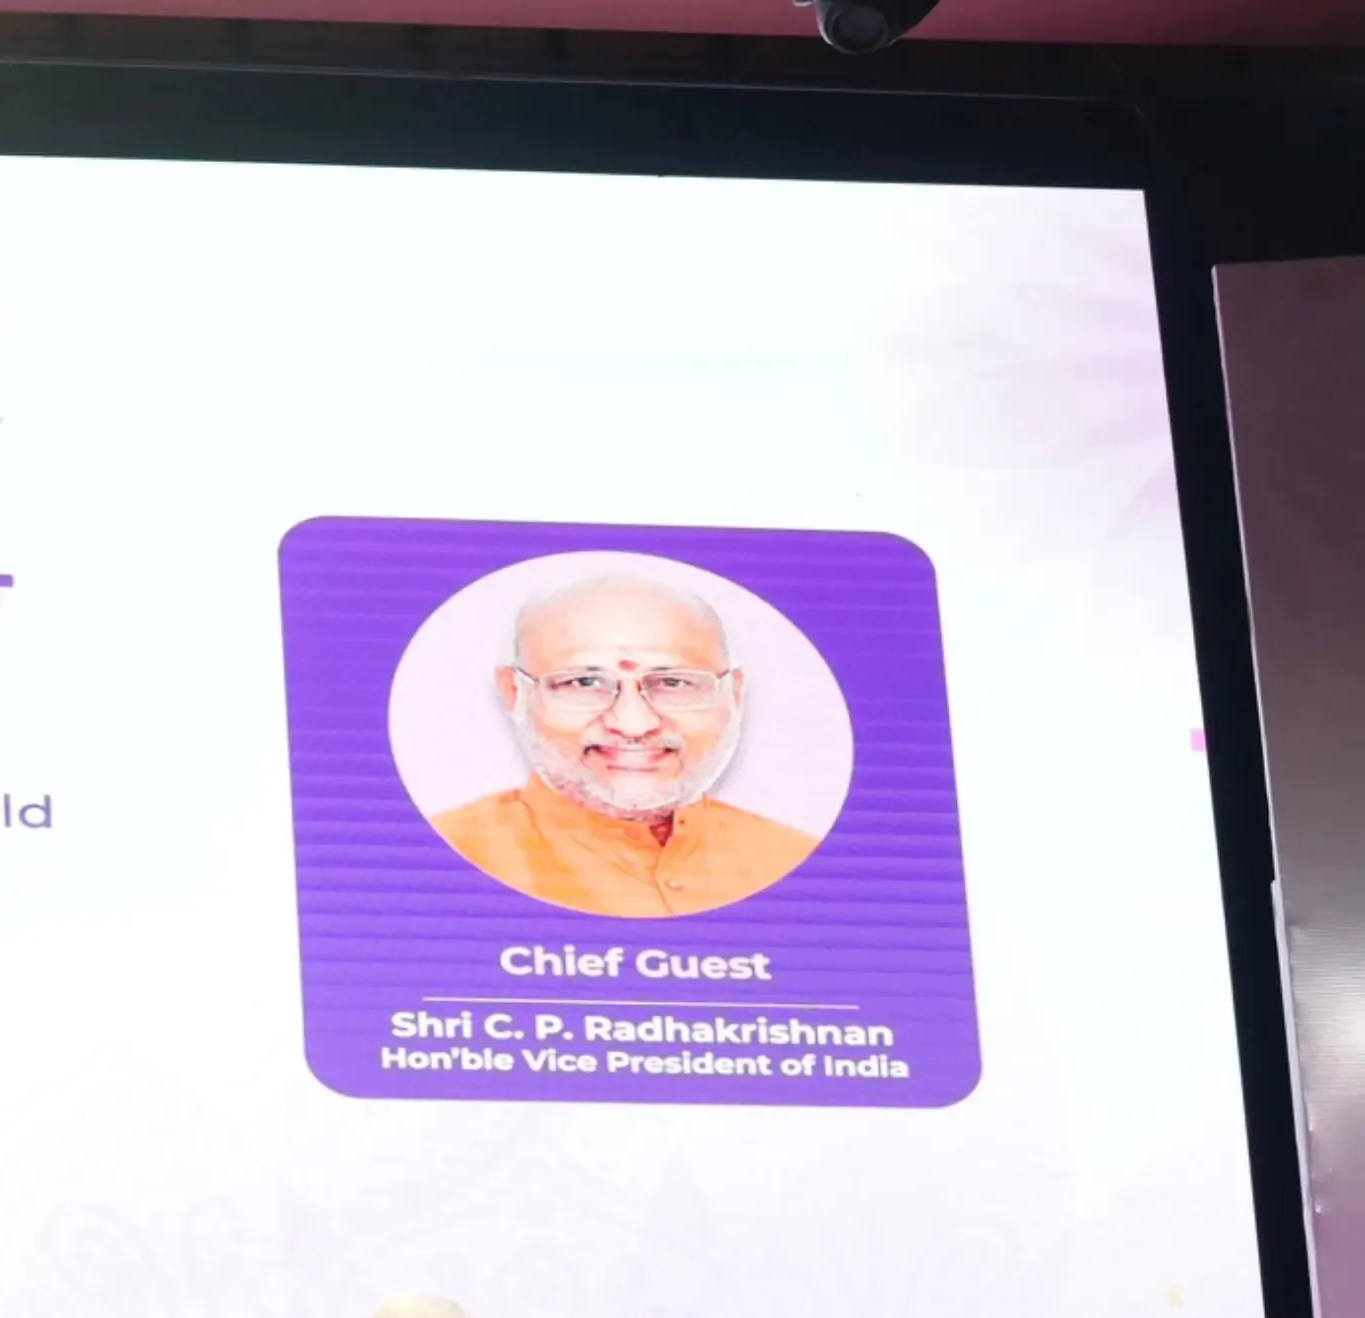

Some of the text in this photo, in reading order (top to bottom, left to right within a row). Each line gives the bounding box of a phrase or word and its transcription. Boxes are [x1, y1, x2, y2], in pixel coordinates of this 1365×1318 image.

[500, 944, 772, 980] Chief Guest
[391, 1010, 894, 1047] Shri C. P. Radhakrishnan
[521, 1047, 598, 1073] Vice
[606, 1050, 773, 1076] President
[779, 1053, 817, 1077] of
[823, 1053, 910, 1078] India
